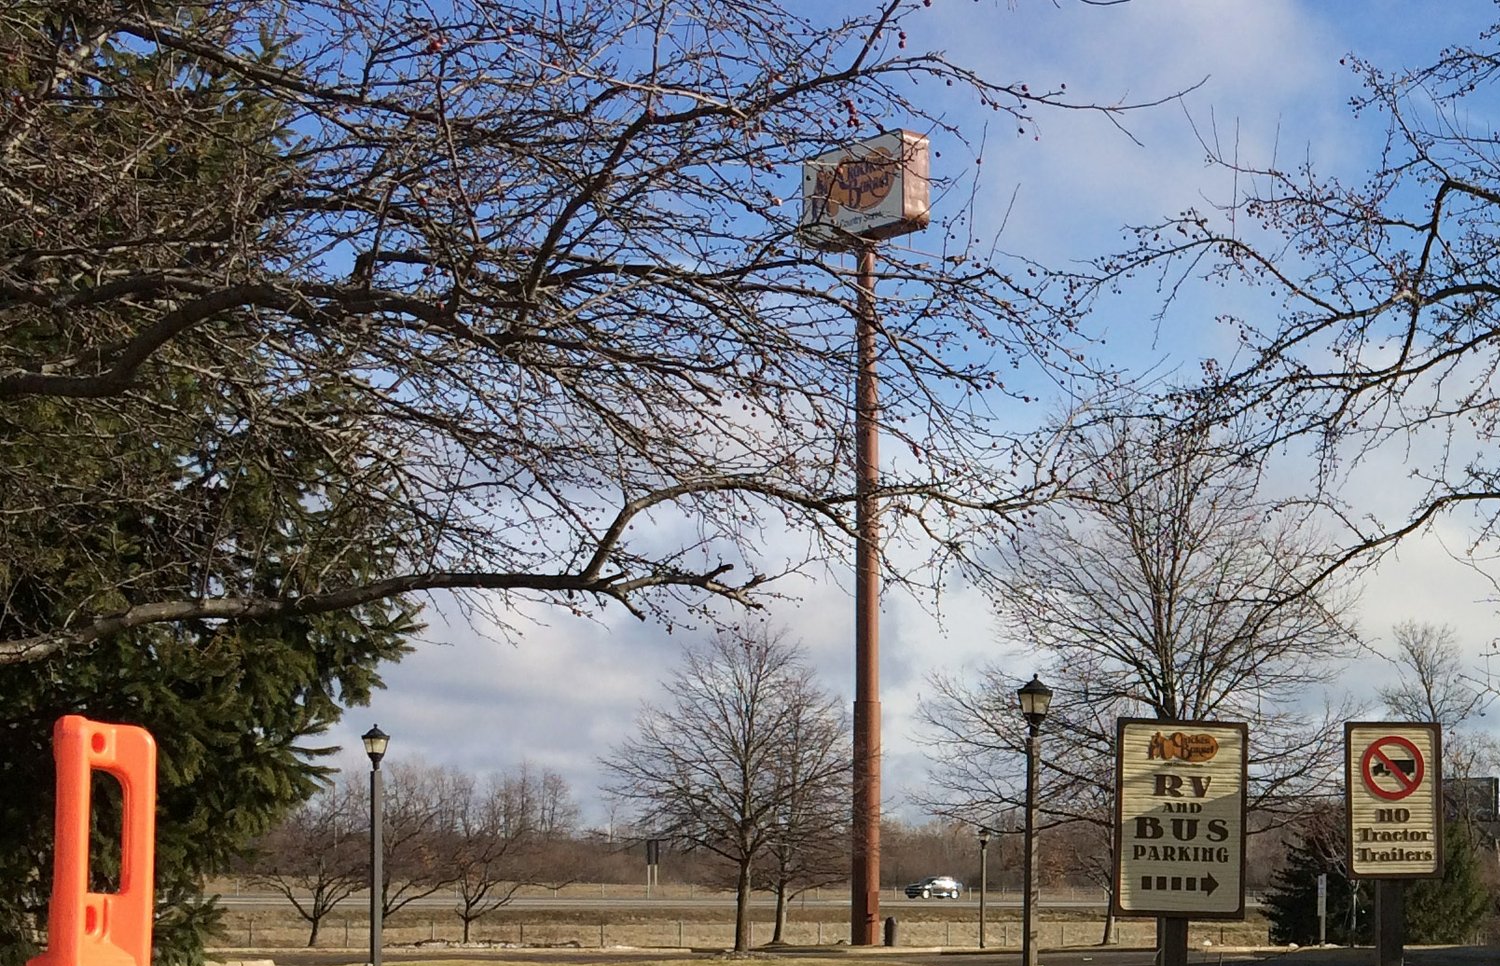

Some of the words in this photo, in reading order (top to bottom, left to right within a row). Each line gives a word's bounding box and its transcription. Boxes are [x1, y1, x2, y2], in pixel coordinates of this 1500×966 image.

[1153, 774, 1211, 798] RV
[1162, 802, 1202, 814] AND
[1376, 808, 1411, 823] NO
[1134, 816, 1229, 842] BUS
[1359, 828, 1431, 841] Tractor
[1133, 845, 1230, 863] PARKING
[1357, 847, 1433, 862] Trailers
